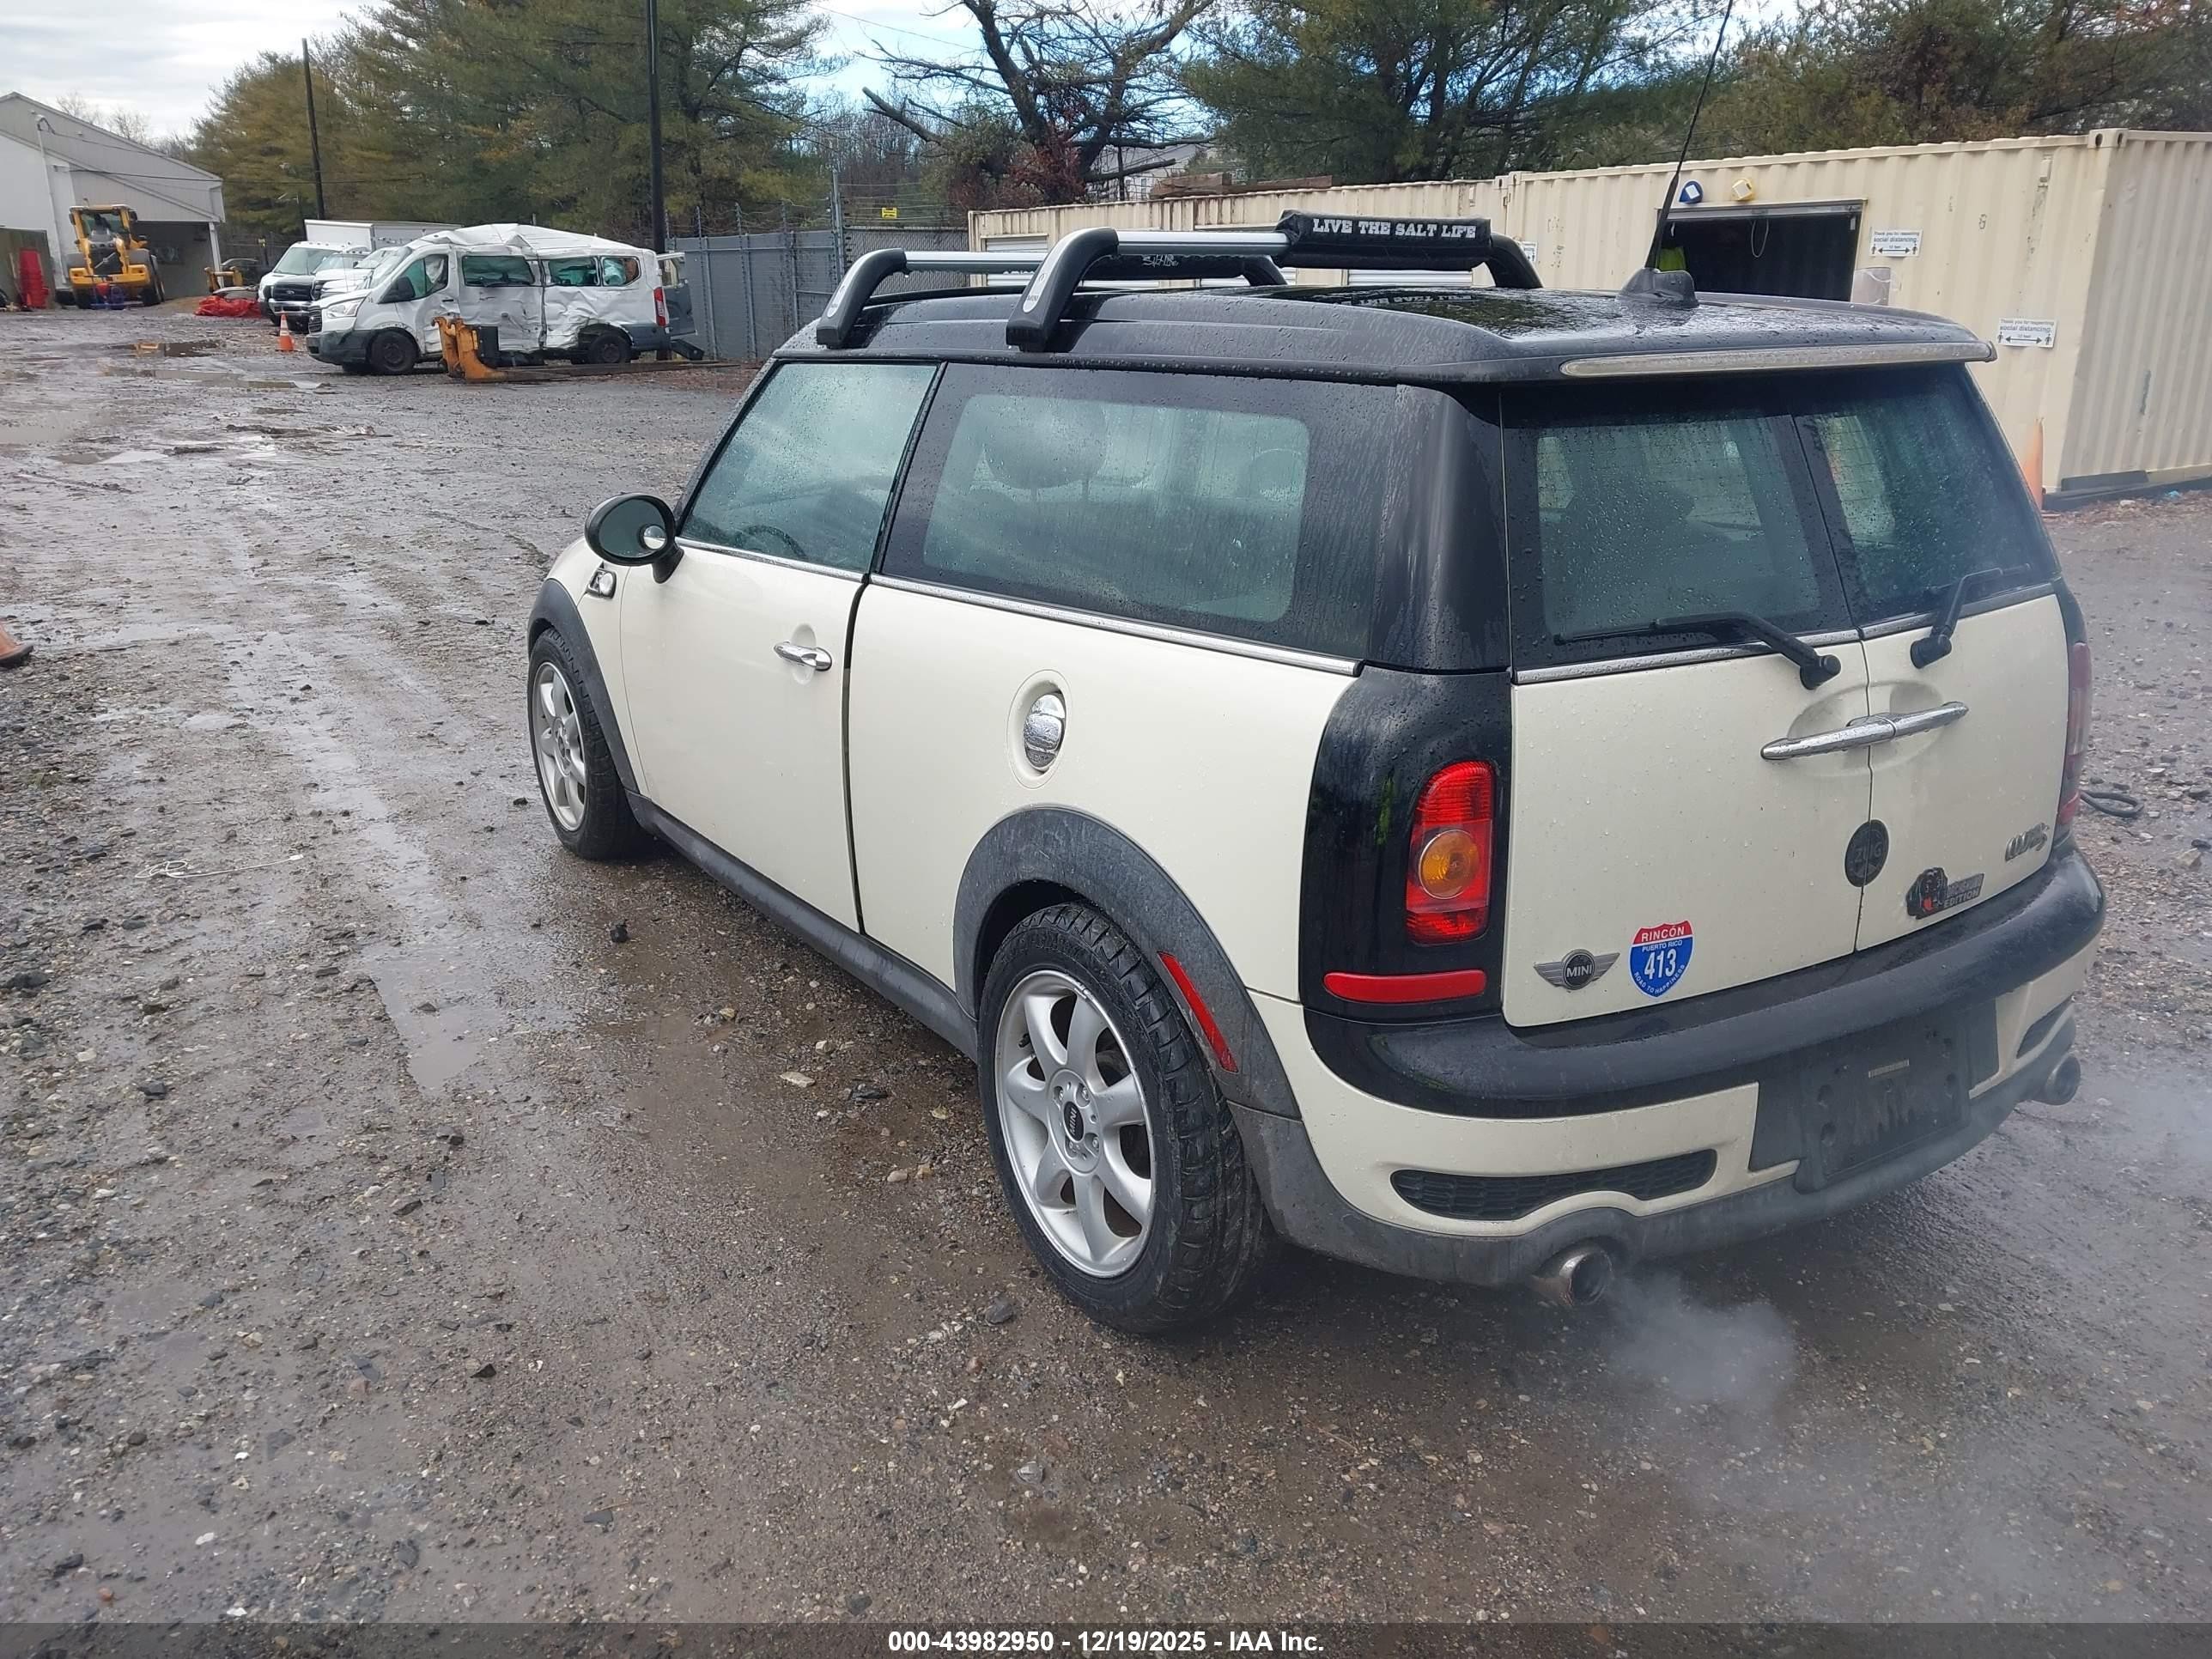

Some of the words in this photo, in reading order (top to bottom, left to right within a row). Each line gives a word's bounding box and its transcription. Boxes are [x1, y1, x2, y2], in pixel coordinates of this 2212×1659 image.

[1313, 218, 1352, 234] LIVE
[1358, 221, 1391, 235] THE
[1395, 222, 1437, 237] SALT
[1441, 225, 1476, 239] LIFE
[1944, 887, 1979, 908] EDITION
[1641, 925, 1685, 943] RINCÓN
[1642, 943, 1667, 952] PUERTO
[1565, 963, 1593, 978] MINI
[1644, 948, 1677, 980] 413
[1633, 971, 1647, 988] ROAD
[1655, 964, 1686, 994] HAPPINESS
